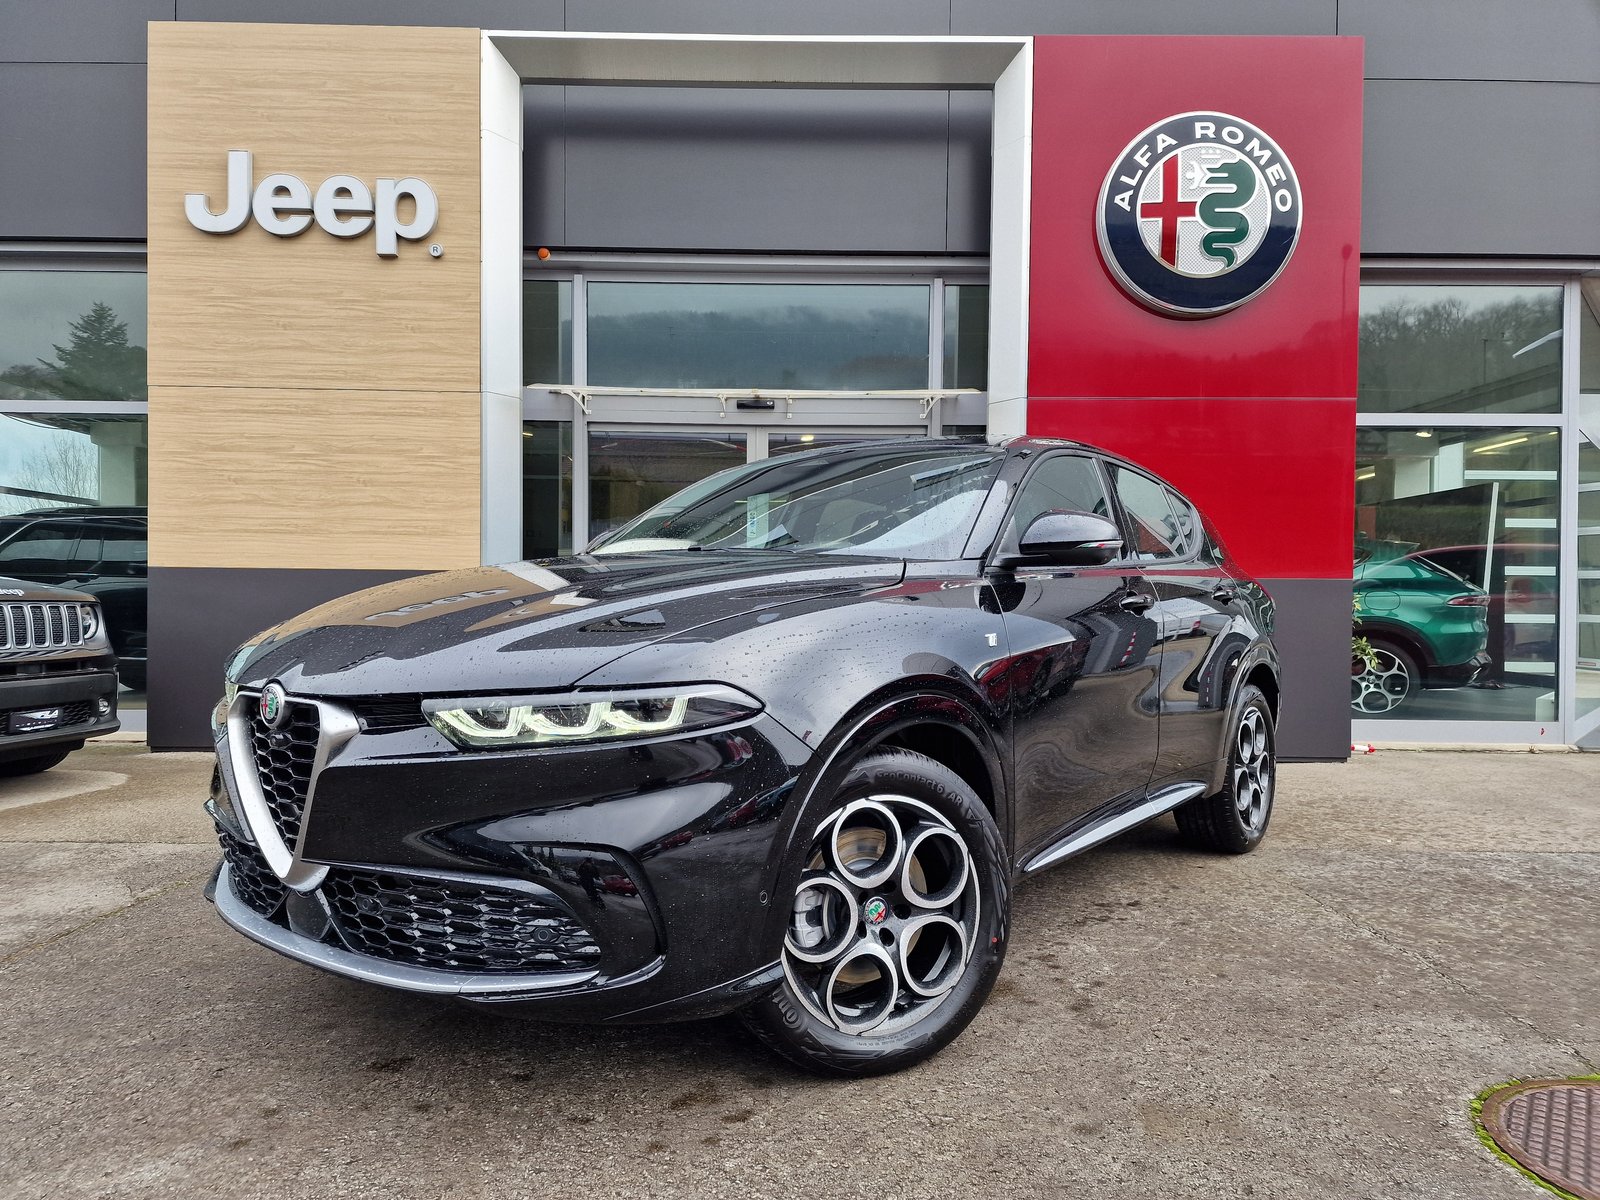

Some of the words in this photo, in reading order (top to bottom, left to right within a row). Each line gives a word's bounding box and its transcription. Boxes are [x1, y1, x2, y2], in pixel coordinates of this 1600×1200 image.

[184, 149, 439, 258] Jeep
[1114, 133, 1178, 212] ALFA
[1194, 121, 1293, 212] ROMEO
